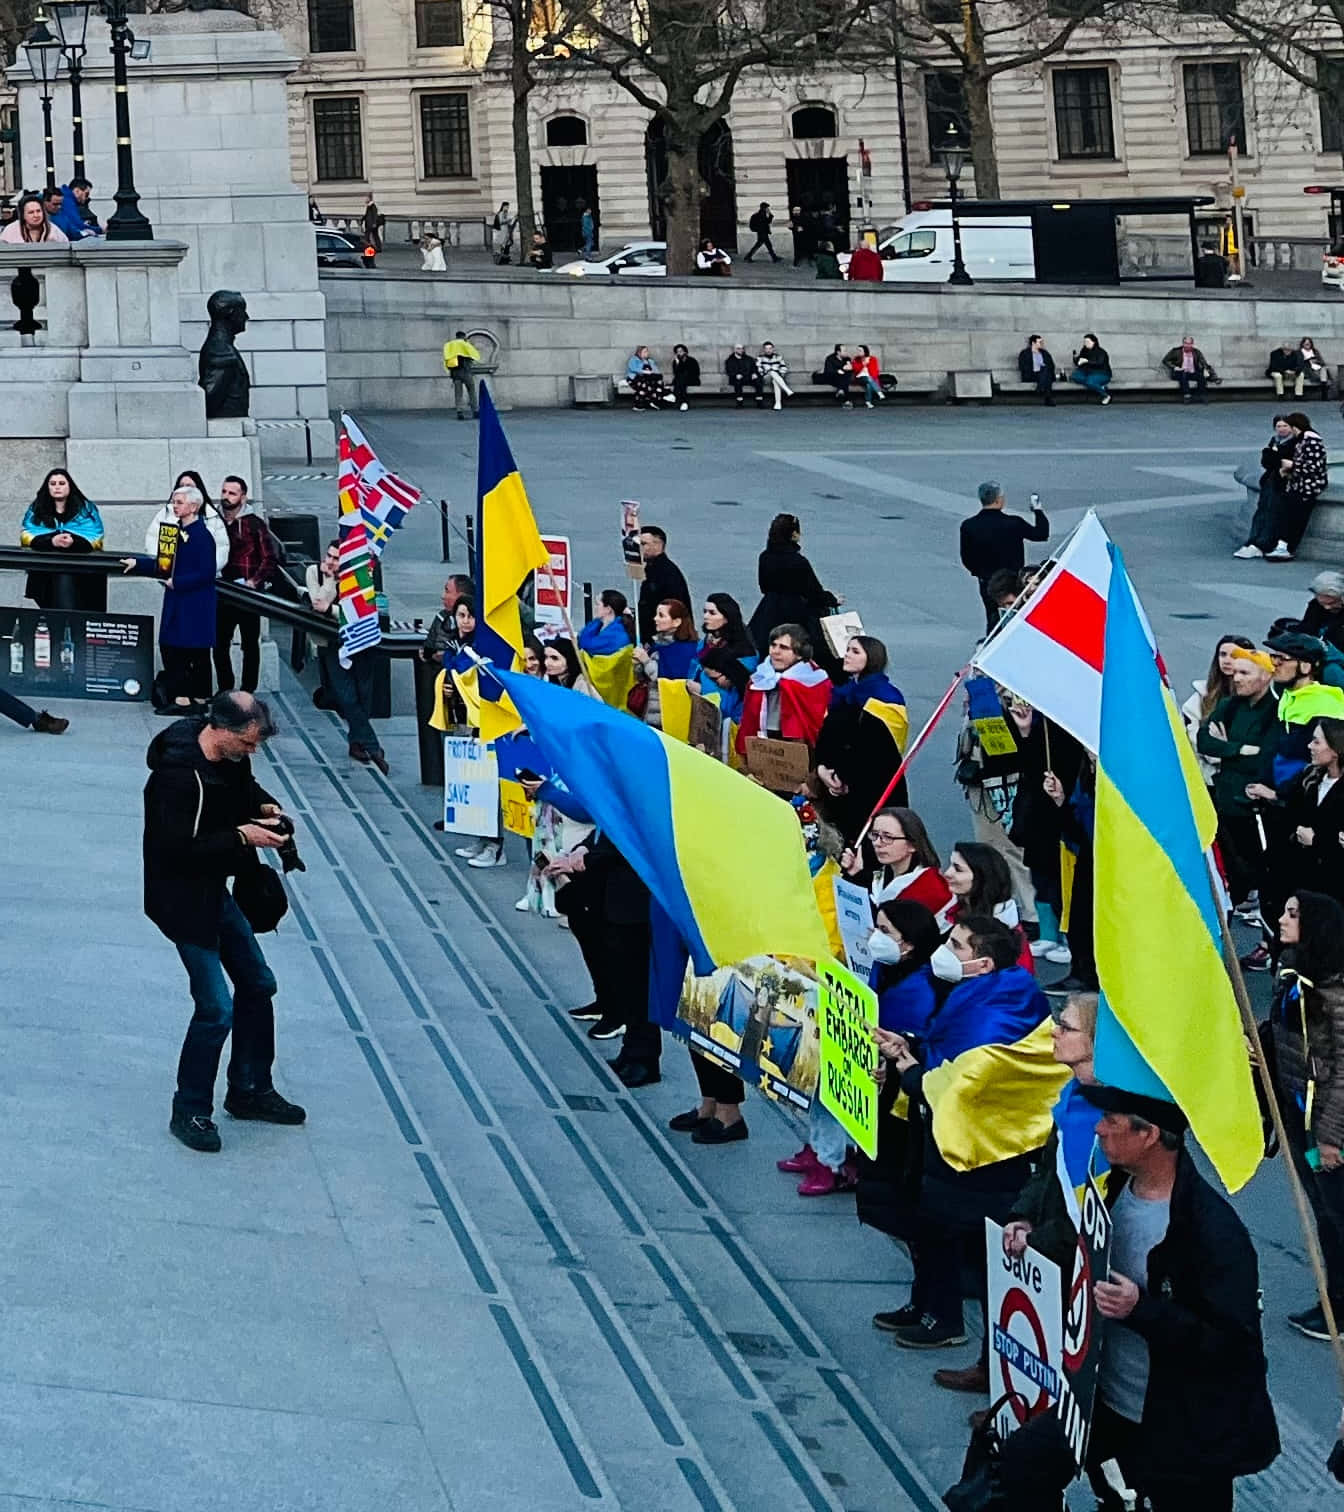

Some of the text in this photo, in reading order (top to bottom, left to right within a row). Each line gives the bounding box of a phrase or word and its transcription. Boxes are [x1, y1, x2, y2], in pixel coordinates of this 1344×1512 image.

[446, 783, 470, 805] SAVE
[824, 971, 870, 1036] TOTAL
[825, 1007, 874, 1079] EMBARGO
[843, 1057, 853, 1077] ON
[827, 1060, 870, 1131] RUSSIA!
[995, 1330, 1056, 1394] STOP PUTIN
[1057, 1369, 1086, 1465] TIN
